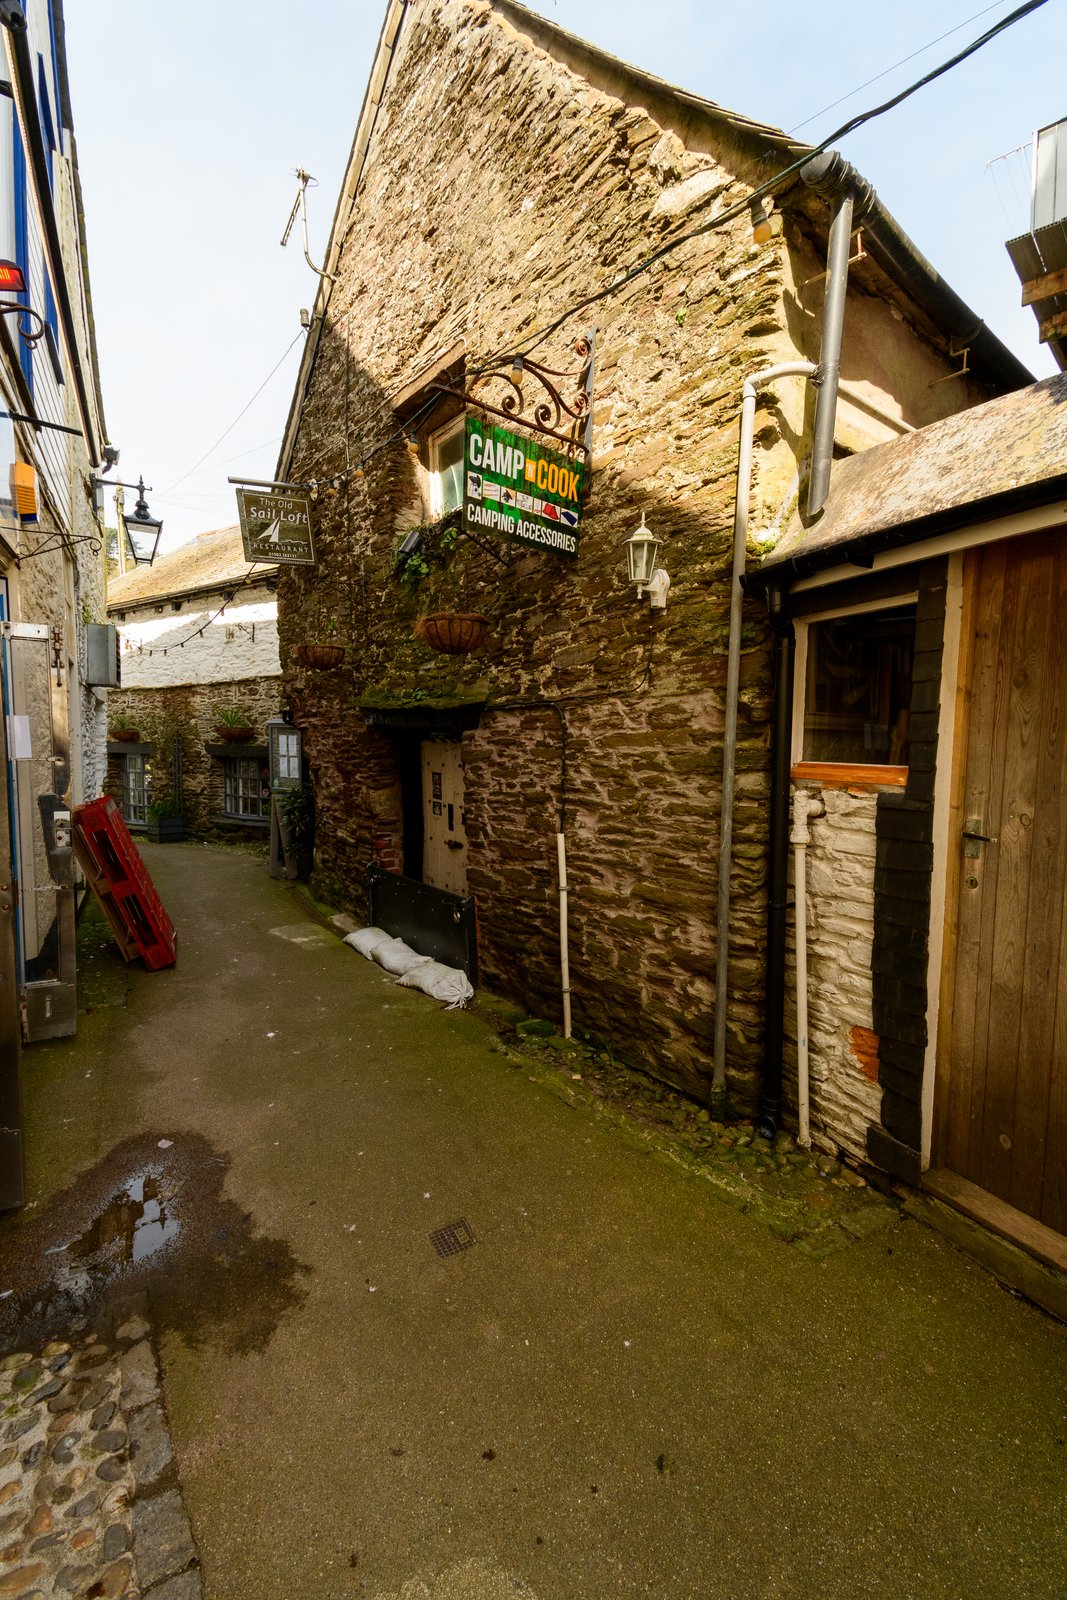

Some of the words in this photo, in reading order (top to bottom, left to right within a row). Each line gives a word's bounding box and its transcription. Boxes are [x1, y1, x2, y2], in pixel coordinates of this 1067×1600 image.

[469, 433, 525, 480] CAMP
[537, 459, 580, 503] COOK
[260, 498, 275, 507] The
[278, 501, 292, 509] Old
[250, 507, 275, 520] Sail
[281, 511, 307, 524] Loft
[467, 503, 515, 534] CAMPING
[515, 518, 576, 553] ACCESSORIES
[253, 543, 308, 553] RESTAURANT
